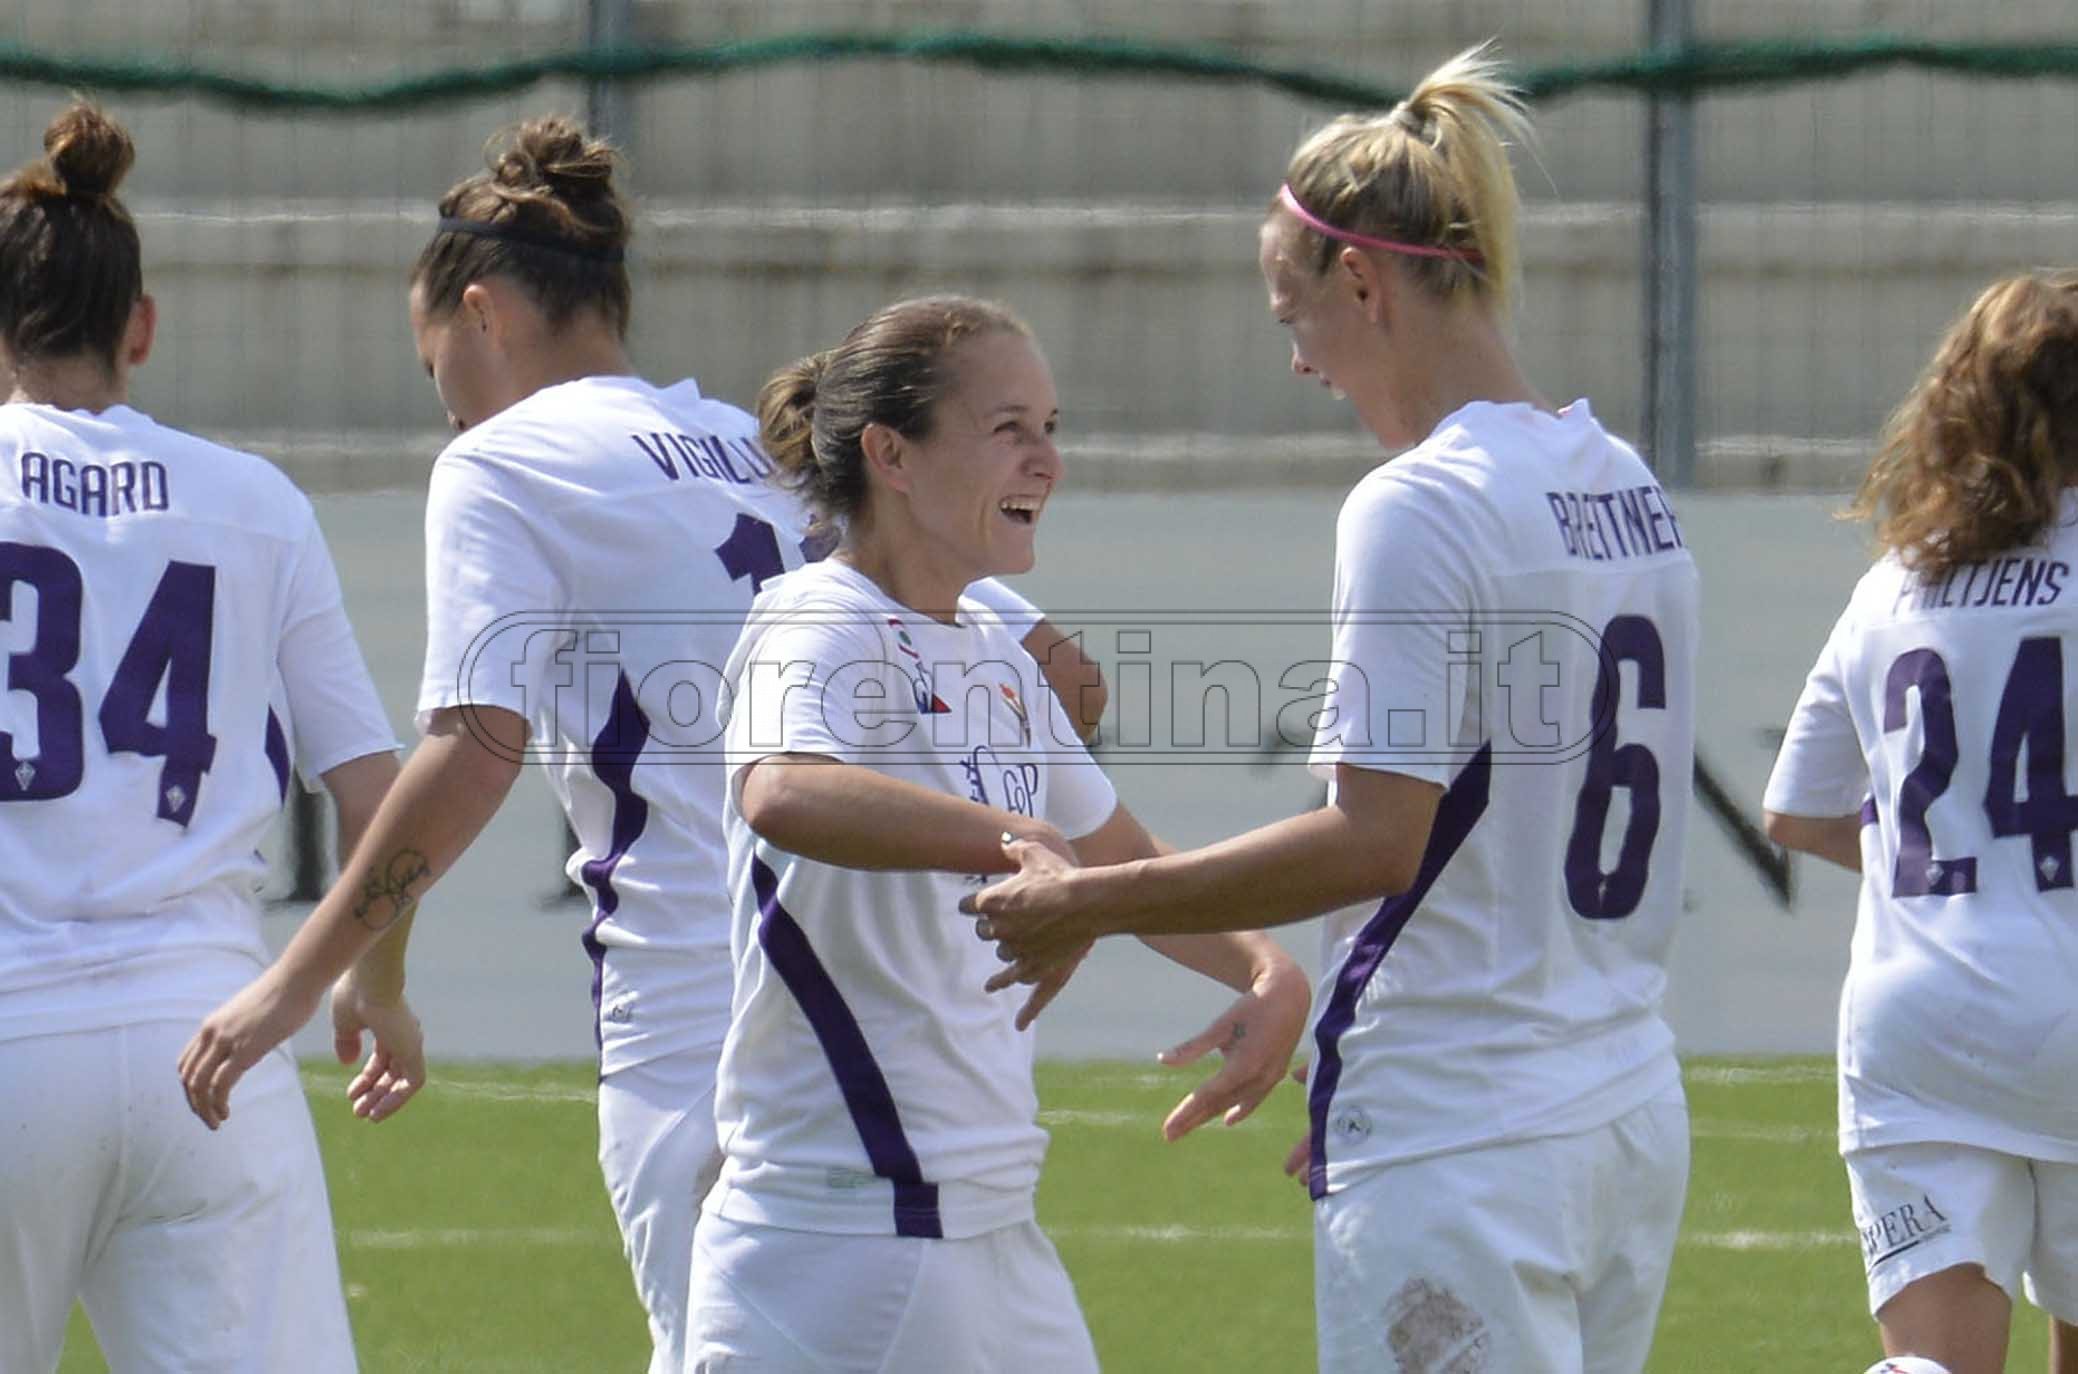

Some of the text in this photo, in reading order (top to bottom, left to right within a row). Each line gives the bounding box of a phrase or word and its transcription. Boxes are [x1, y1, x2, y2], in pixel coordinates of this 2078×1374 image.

[21, 452, 169, 517] AGARD
[631, 431, 776, 484] VIGILU
[0, 540, 216, 826] 34
[1564, 614, 1666, 919] 6
[1883, 636, 2078, 897] 24
